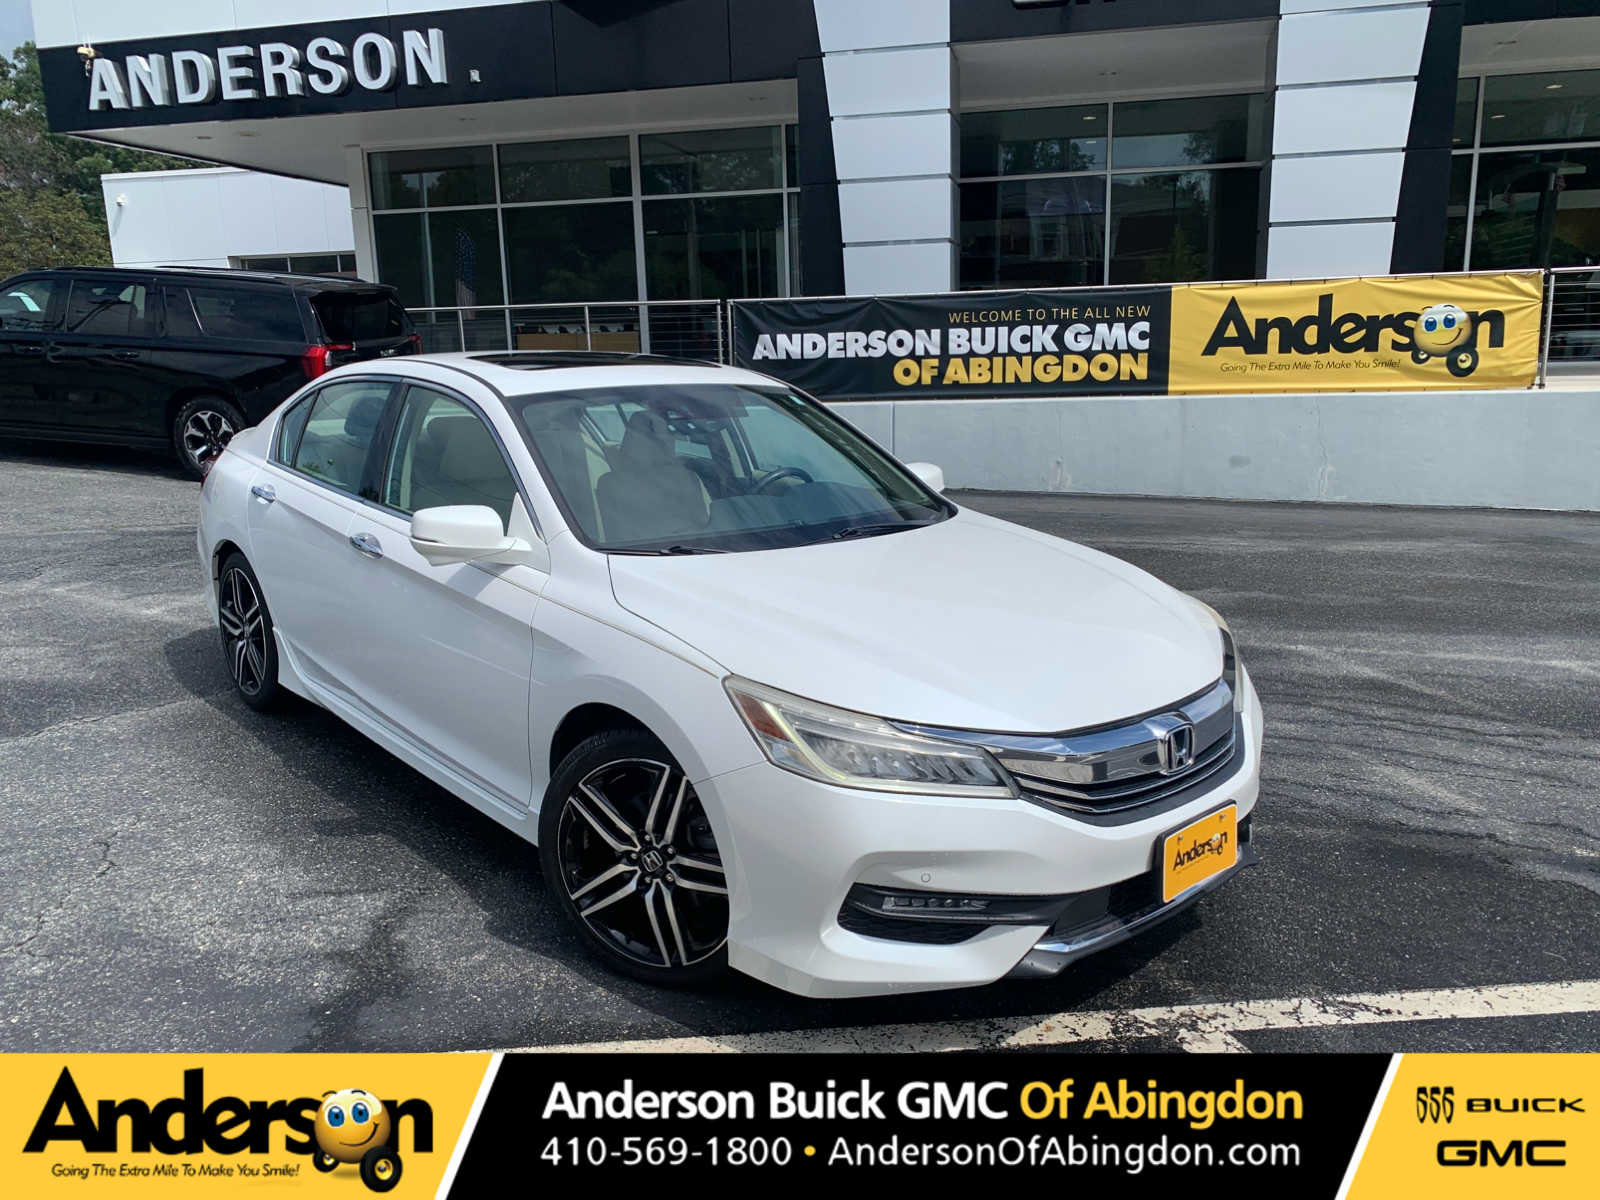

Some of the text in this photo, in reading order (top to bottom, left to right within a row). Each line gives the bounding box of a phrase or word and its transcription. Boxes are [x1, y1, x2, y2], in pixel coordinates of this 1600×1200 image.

[88, 27, 449, 112] ANDERSON
[949, 304, 1151, 324] WELCOME TO THE ALL NEW
[752, 320, 1151, 360] ANDERSON BUICK GMC
[893, 351, 1149, 386] OF ABINGDON
[1220, 358, 1401, 373] Going The Extra Mile To Make You Smile!
